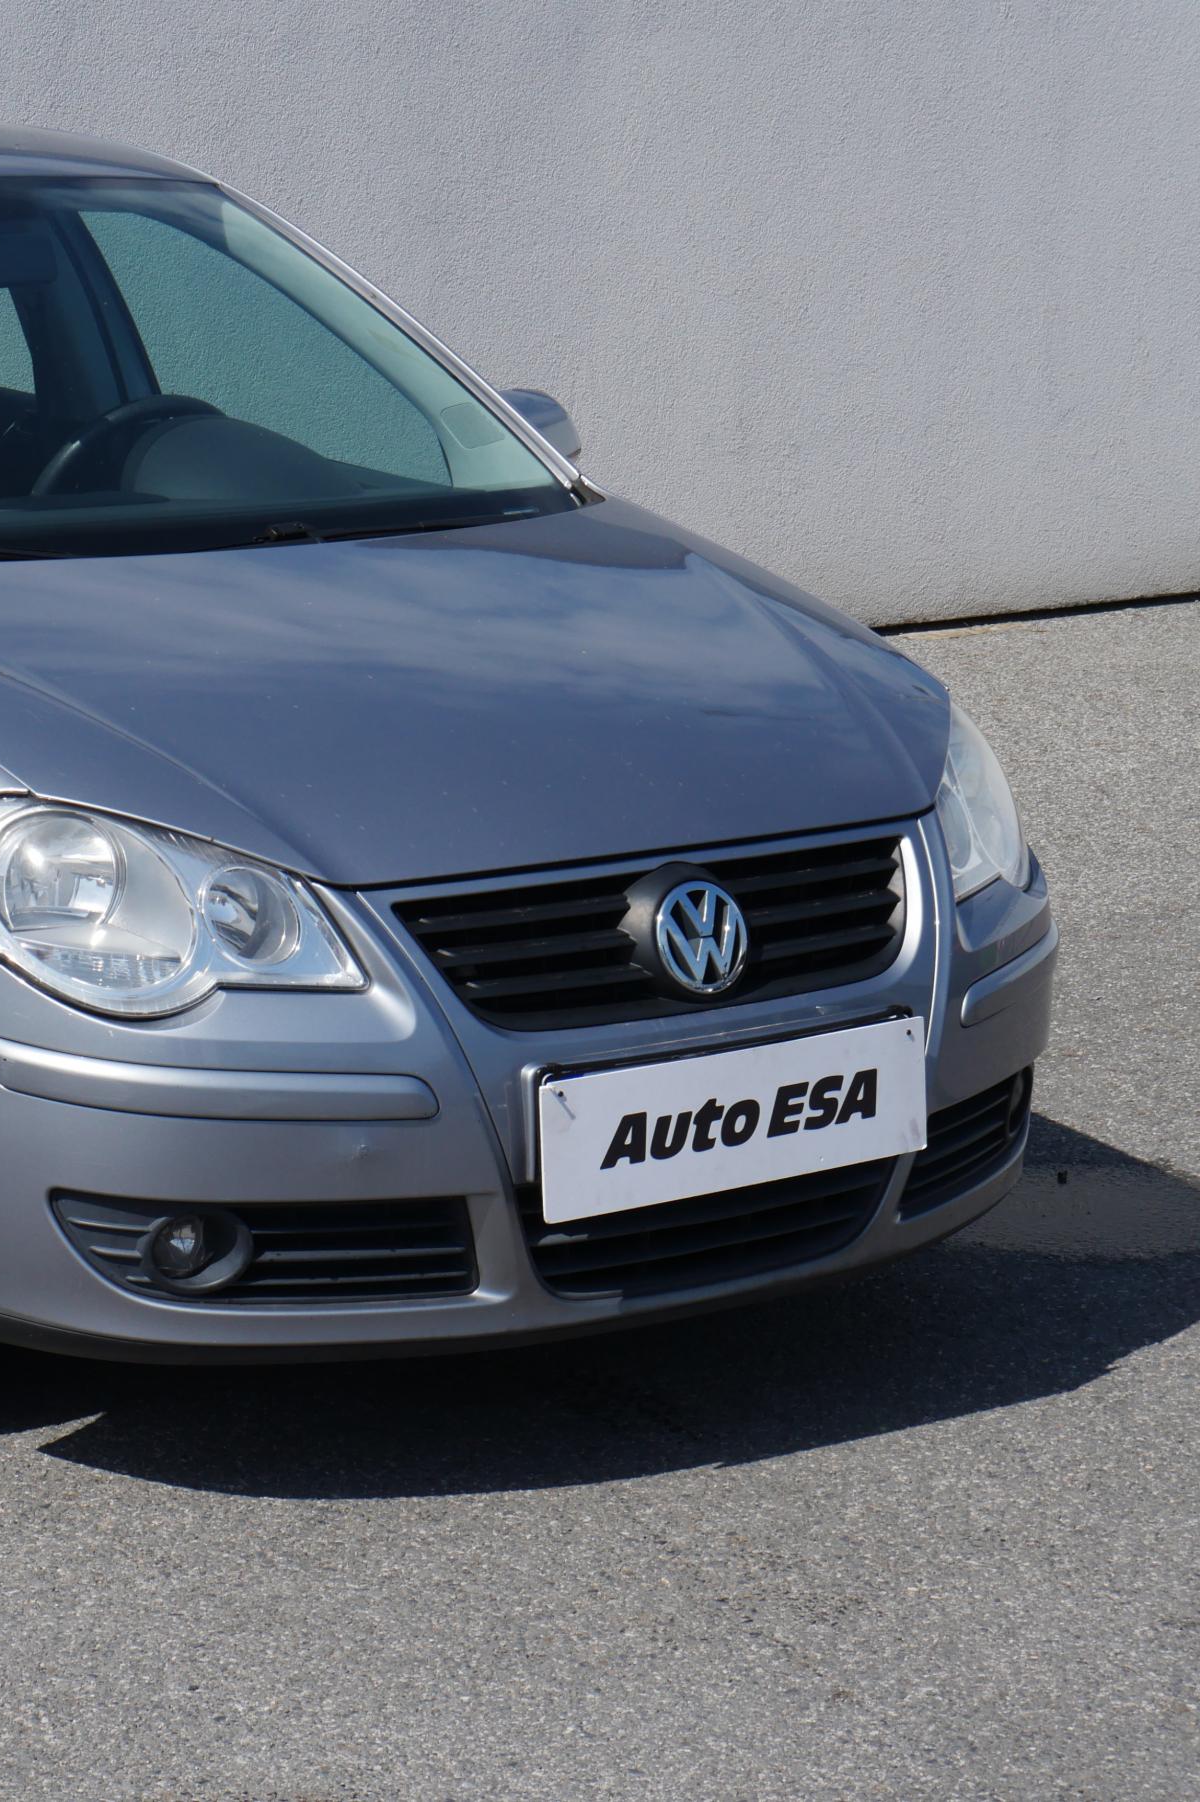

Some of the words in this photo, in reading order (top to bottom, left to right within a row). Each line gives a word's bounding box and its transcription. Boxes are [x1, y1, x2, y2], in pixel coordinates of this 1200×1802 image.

[659, 883, 744, 990] VW
[600, 1098, 760, 1170] Auto
[767, 1068, 878, 1138] ESA
